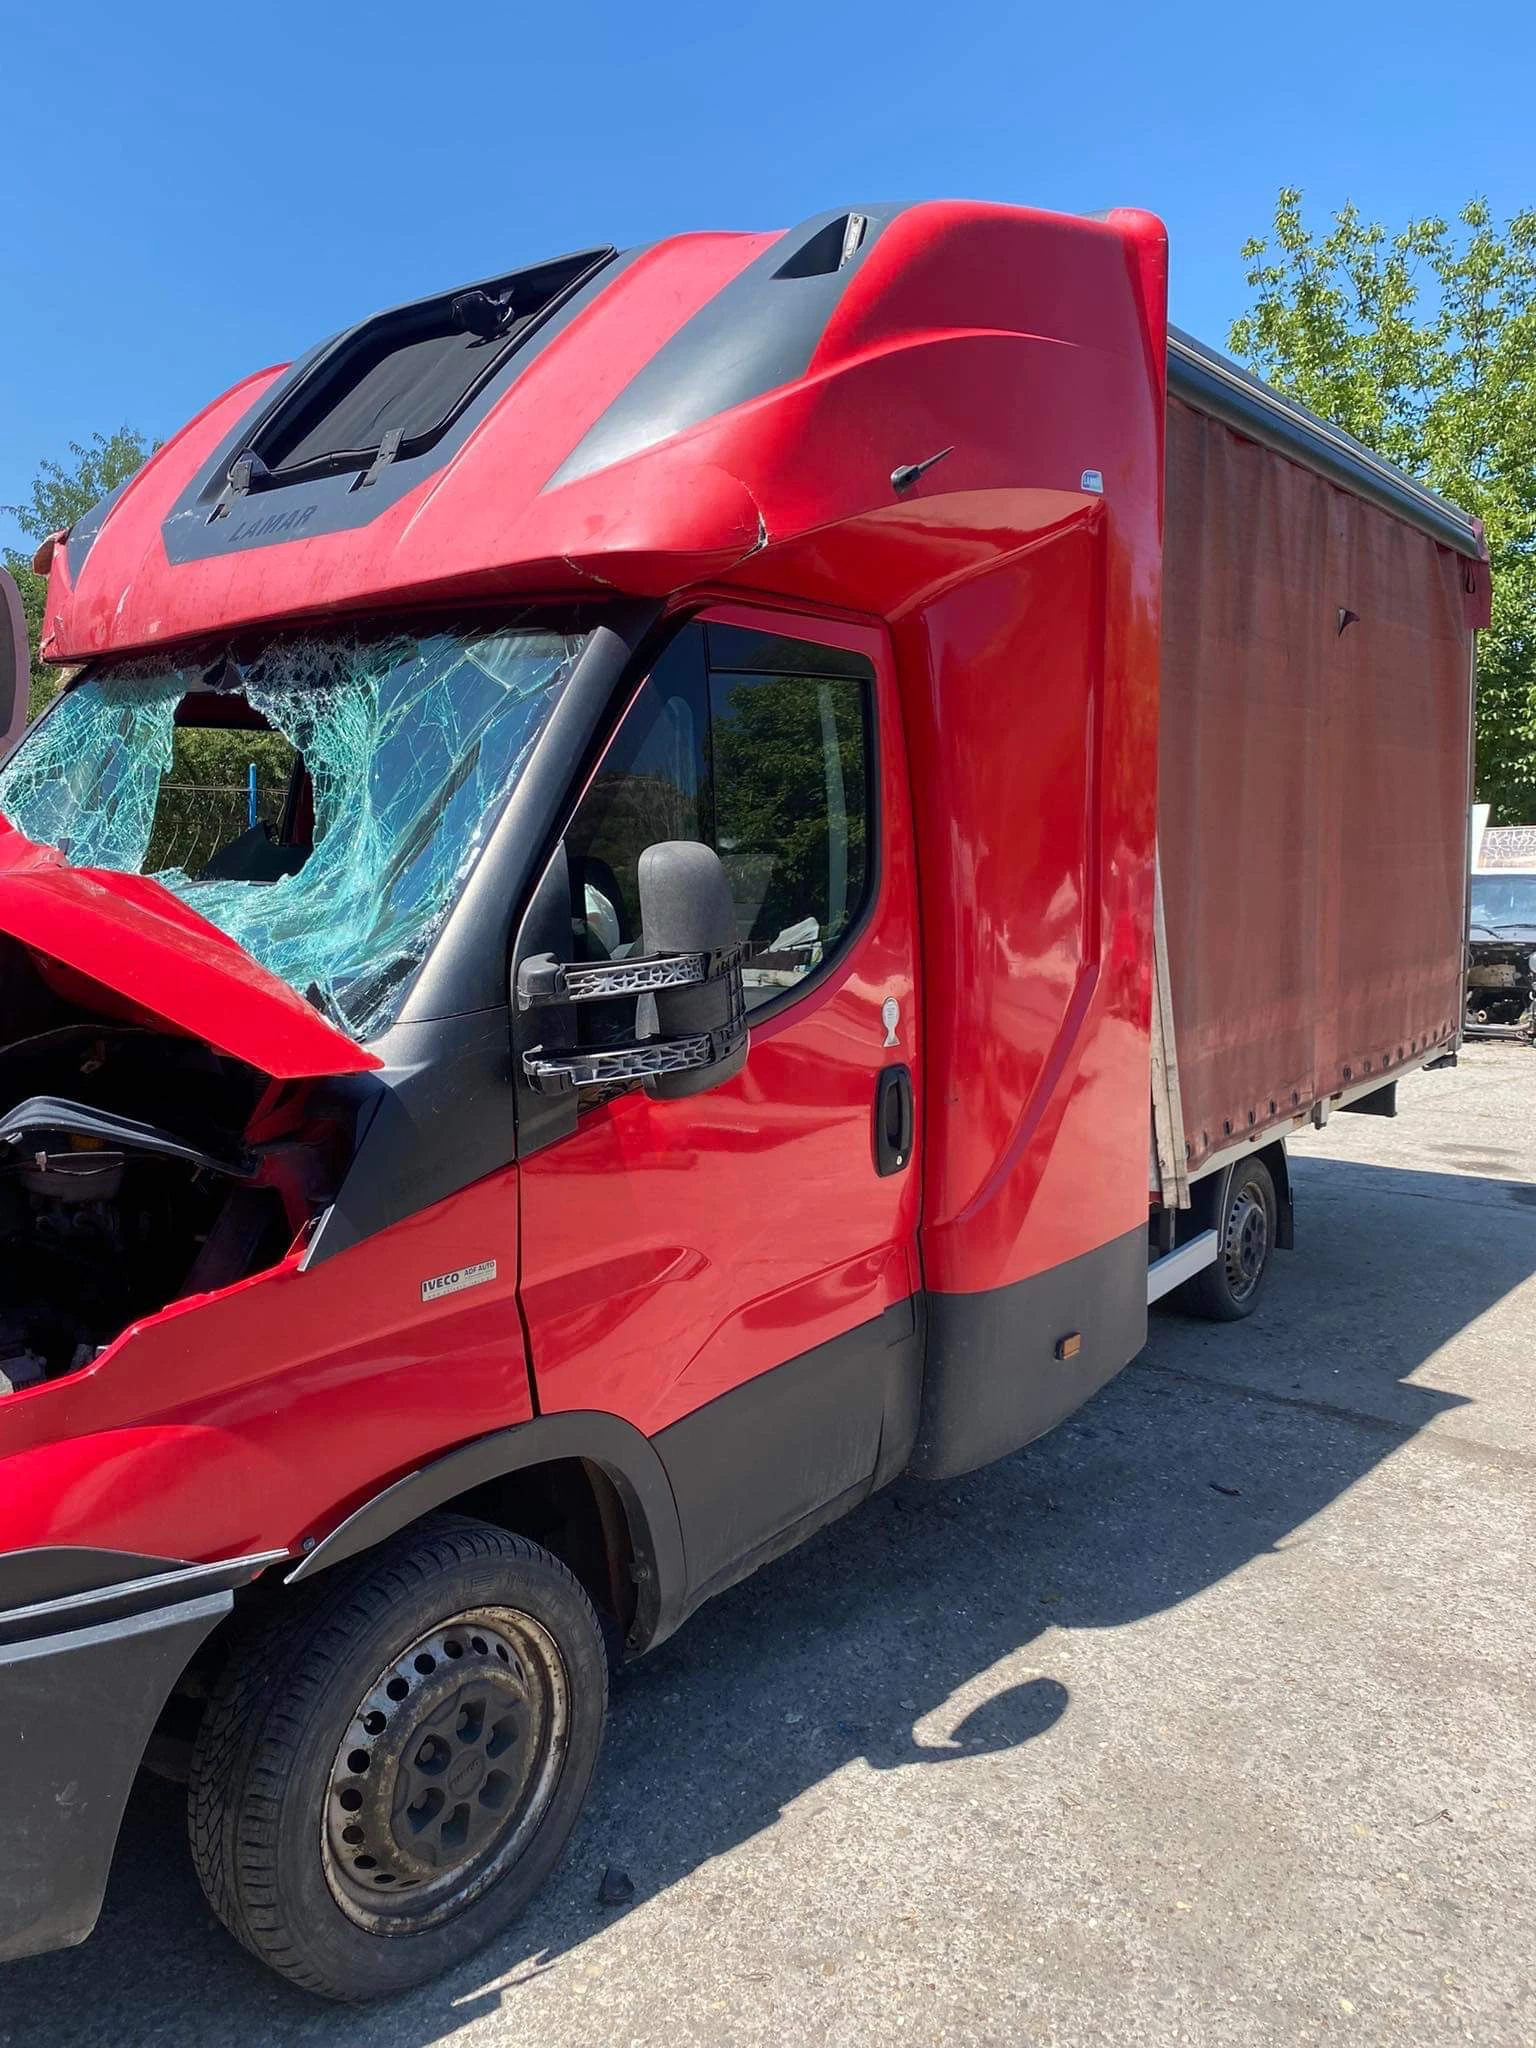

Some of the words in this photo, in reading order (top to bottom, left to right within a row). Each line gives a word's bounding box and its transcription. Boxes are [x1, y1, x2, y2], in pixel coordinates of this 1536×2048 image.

[227, 504, 319, 543] LAMAR
[478, 1262, 495, 1271] AUTO
[423, 1273, 460, 1292] IVECO
